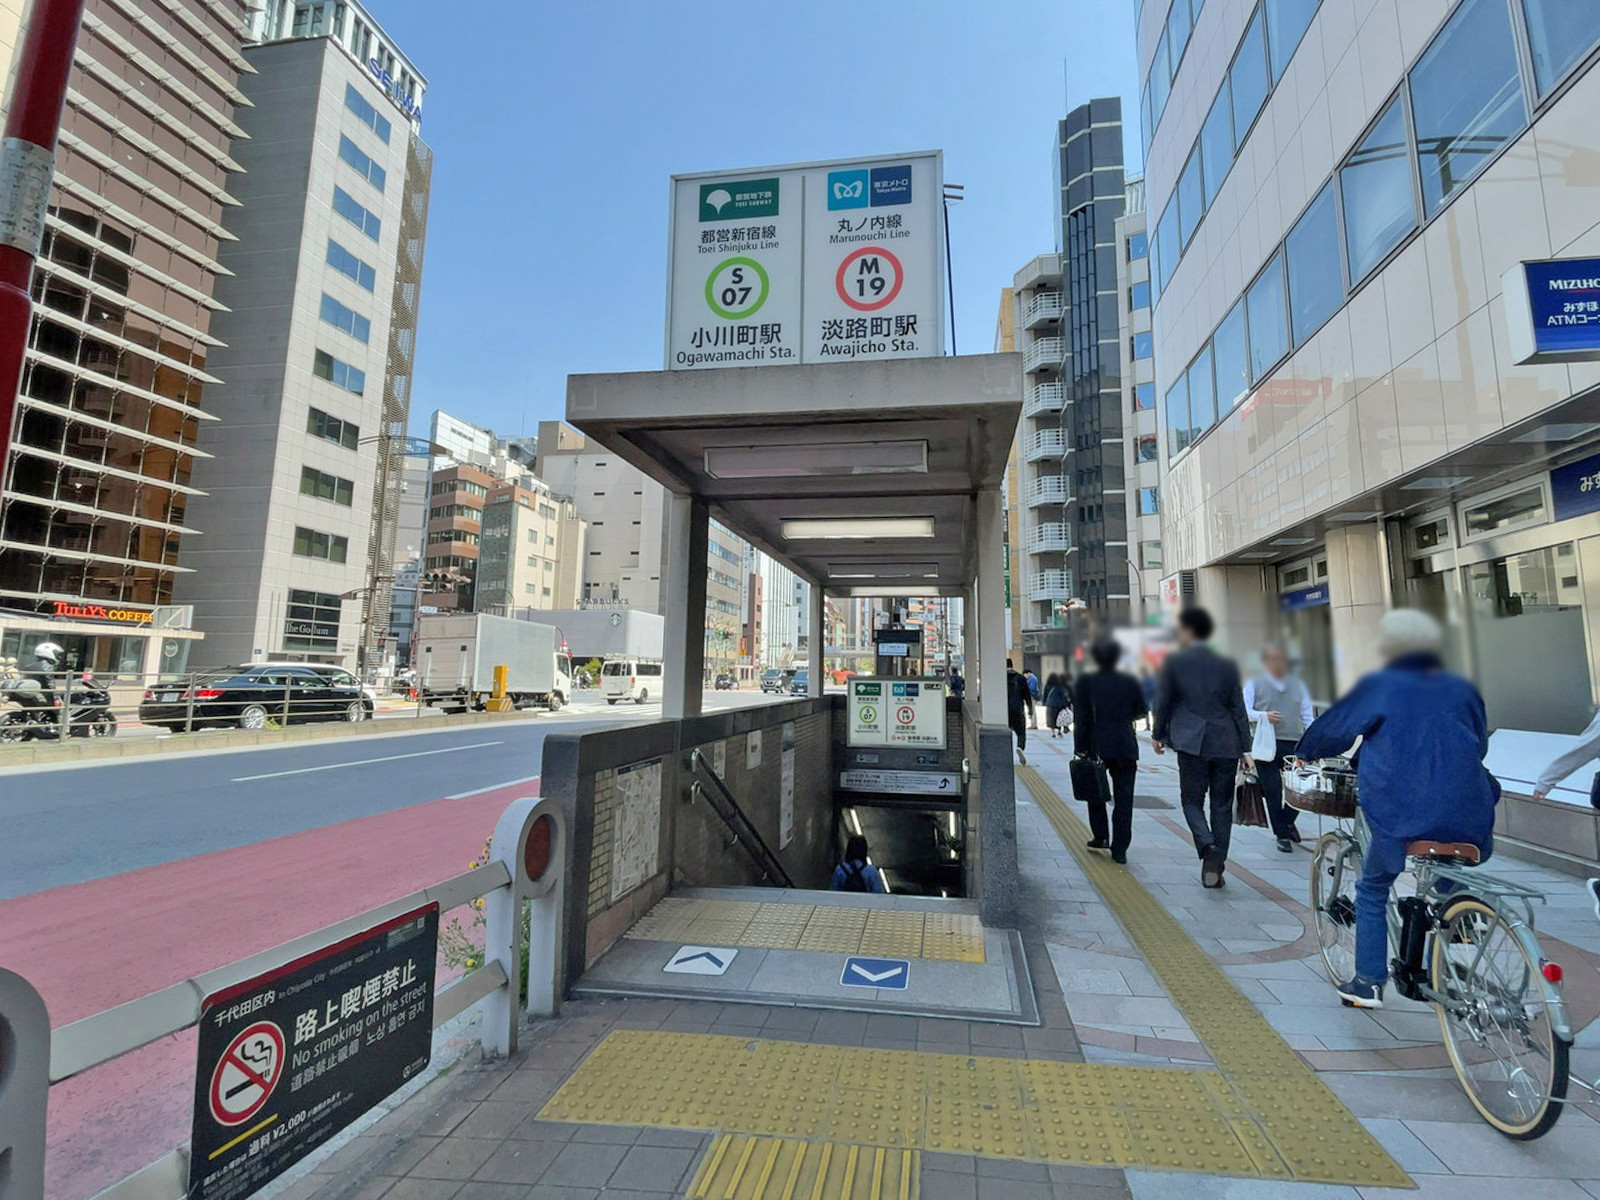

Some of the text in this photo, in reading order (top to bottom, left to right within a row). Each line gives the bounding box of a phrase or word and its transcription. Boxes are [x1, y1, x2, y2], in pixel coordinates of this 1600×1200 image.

[874, 179, 908, 188] 東京メトロ
[735, 190, 772, 201] 都営地下鉄
[837, 214, 902, 233] 丸ノ内線
[701, 225, 777, 244] 都営新宿線
[829, 228, 911, 244] Marunouchi Line
[698, 240, 780, 254] Toei Shinjuku Line
[731, 267, 744, 284] S
[858, 257, 880, 275] M
[721, 286, 753, 306] 07
[856, 277, 886, 297] 19
[1563, 301, 1599, 313] みずほ
[821, 314, 918, 340] 淡路町駅
[1547, 314, 1600, 326] ATMコー
[691, 323, 782, 348] 小川町駅
[676, 346, 796, 367] Ogawamachi Sta.
[820, 338, 919, 358] Awajicho Sta.
[214, 990, 276, 1027] 千代田区内
[293, 958, 417, 1046] 路上喫煙禁止
[292, 981, 428, 1070] No smoking on the street
[365, 1022, 386, 1047] 노상
[408, 999, 426, 1021] 금지
